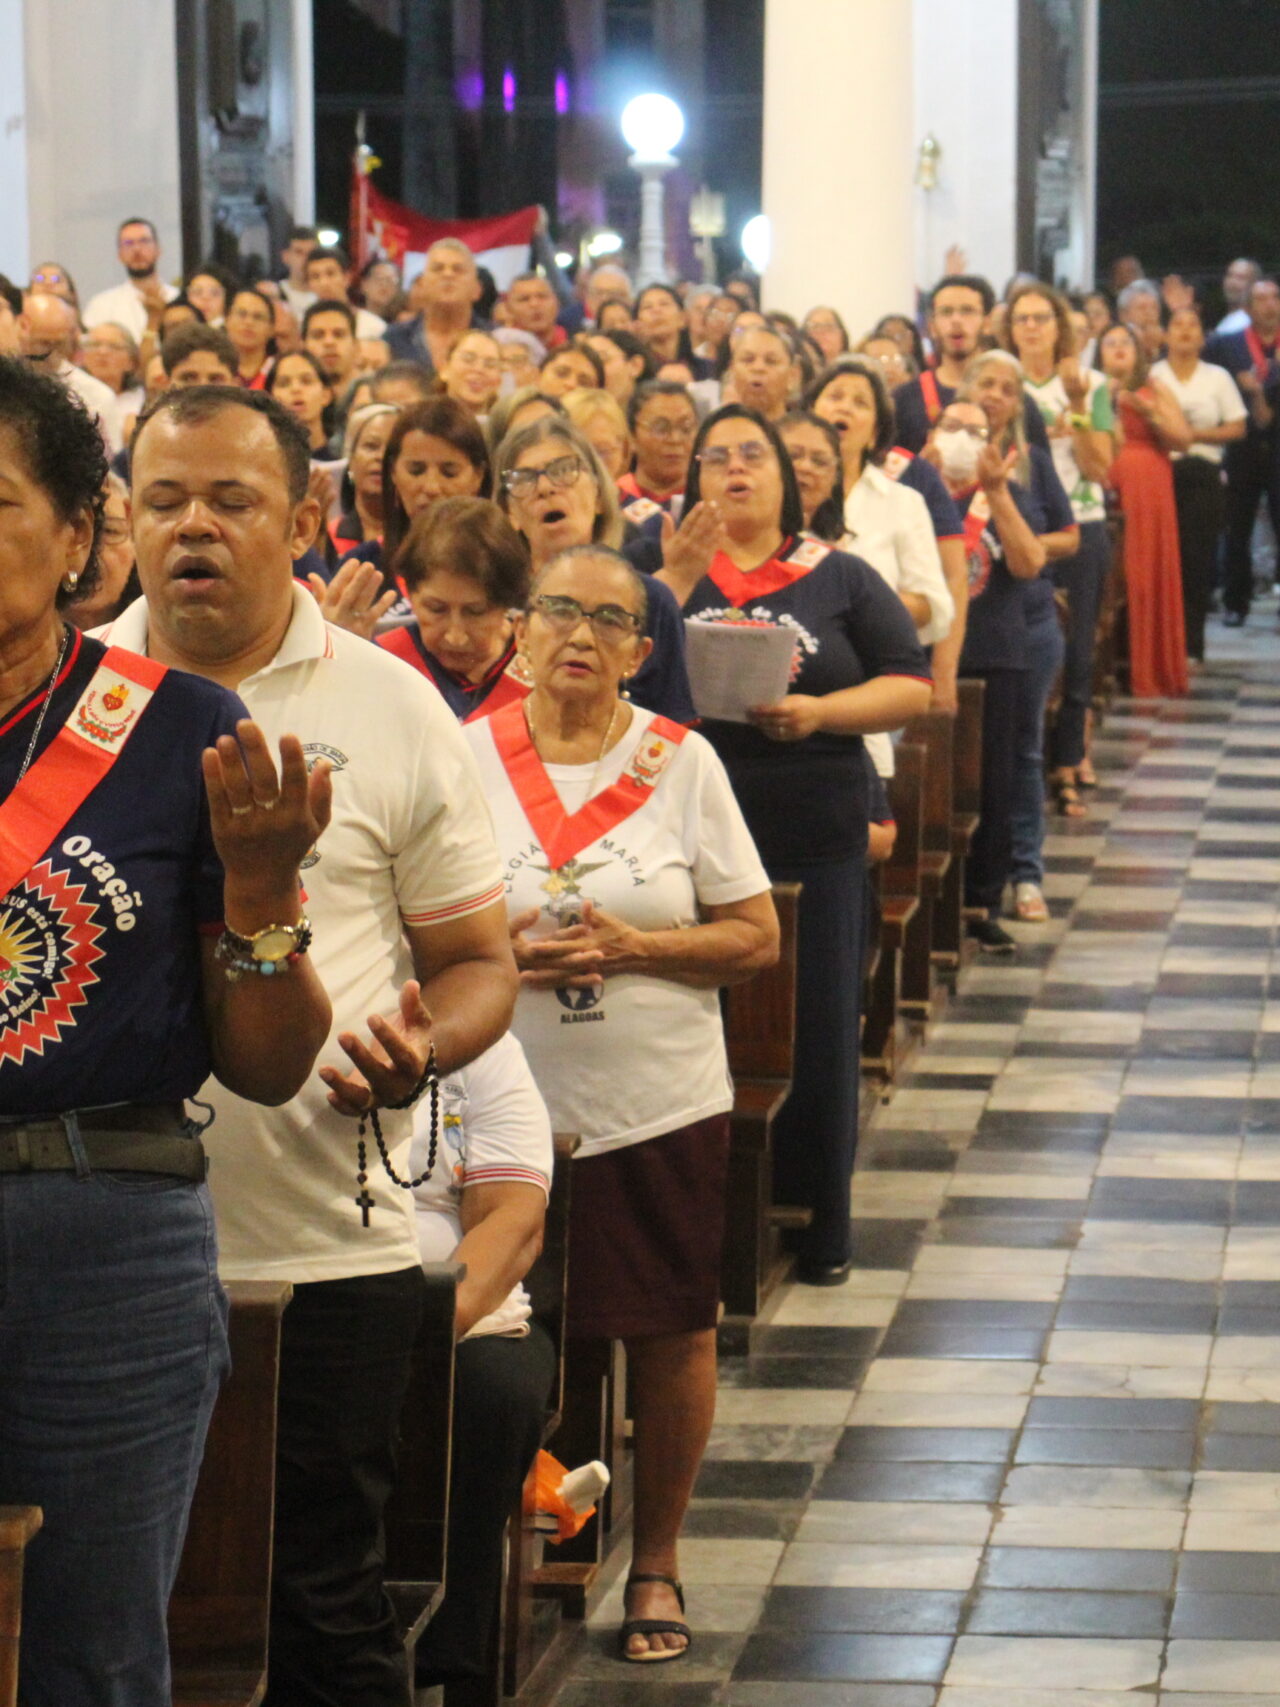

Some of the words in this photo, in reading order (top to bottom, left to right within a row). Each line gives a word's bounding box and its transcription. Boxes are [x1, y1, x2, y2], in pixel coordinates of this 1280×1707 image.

[599, 838, 646, 887] MARIA
[62, 835, 143, 932] Oração
[26, 906, 52, 930] está
[561, 1011, 605, 1024] ALAGOAS
